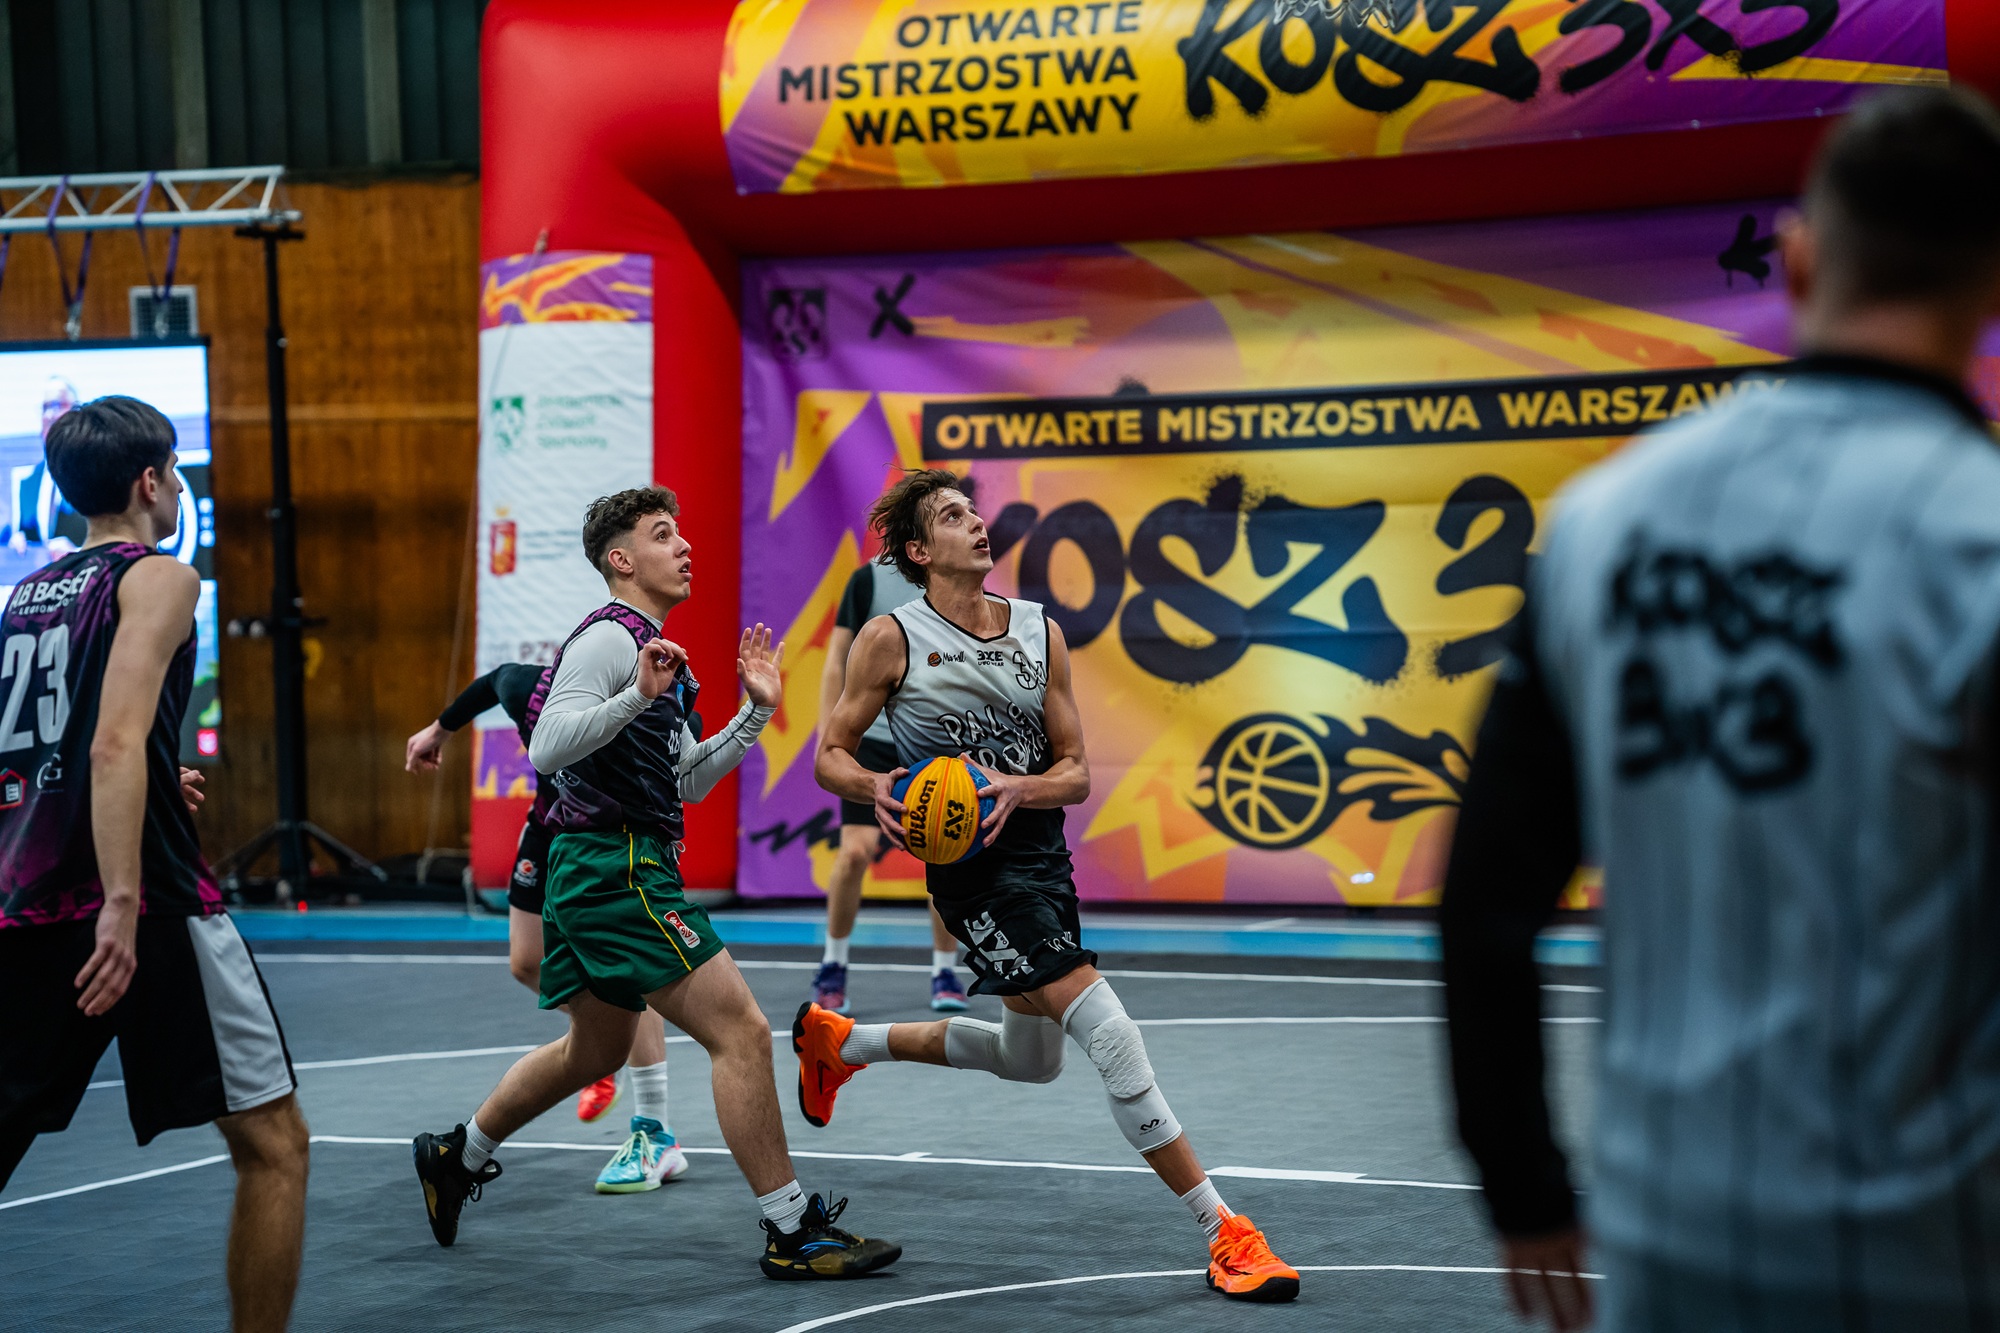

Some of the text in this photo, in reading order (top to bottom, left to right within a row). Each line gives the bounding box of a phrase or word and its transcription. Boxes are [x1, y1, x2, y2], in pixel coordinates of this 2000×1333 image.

[898, 0, 1142, 48] OTWARTE
[779, 46, 1138, 103] MISTRZOSTWA
[843, 93, 1140, 147] WARSZAWY
[936, 408, 1143, 450] OTWARTE
[1156, 394, 1482, 443] MISTRZOSTWA
[7, 582, 35, 613] AB
[985, 472, 1408, 688] OSZ
[0, 622, 71, 754] 23
[909, 779, 938, 849] Wilson
